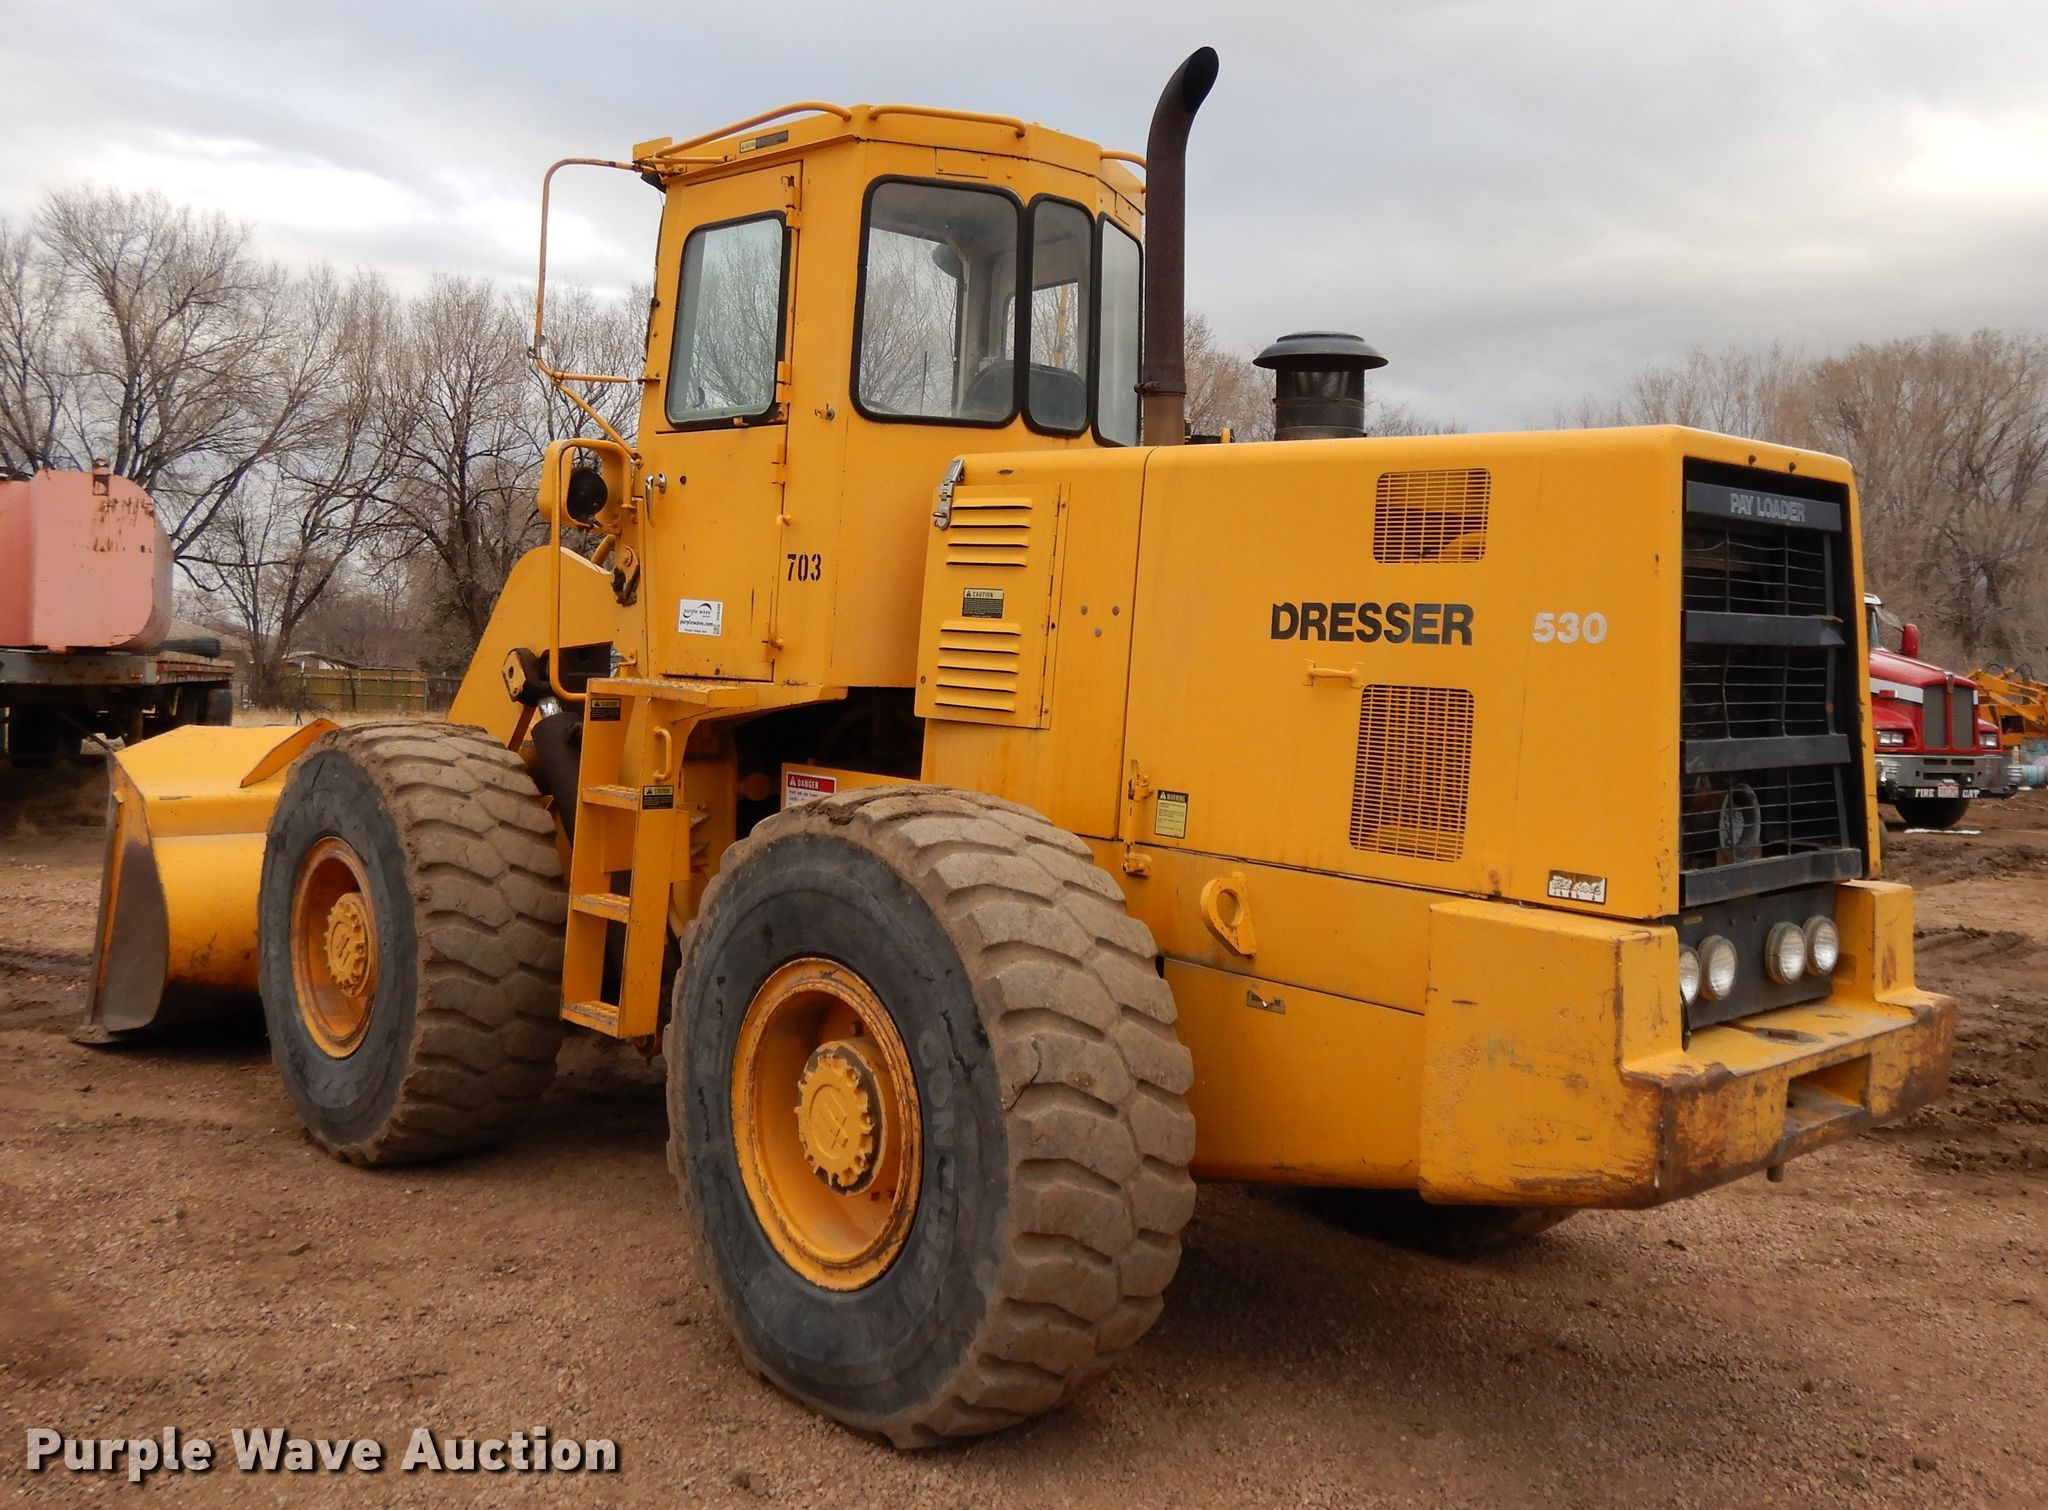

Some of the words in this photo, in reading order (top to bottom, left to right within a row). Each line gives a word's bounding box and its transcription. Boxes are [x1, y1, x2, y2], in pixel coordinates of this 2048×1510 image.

[1730, 493, 1753, 515] PAY
[1757, 496, 1805, 522] LOADER
[787, 553, 821, 582] 703
[1271, 602, 1474, 645] DRESSER
[1532, 612, 1607, 644] 530
[797, 779, 819, 790] DANGER
[1915, 788, 1935, 798] FIRE
